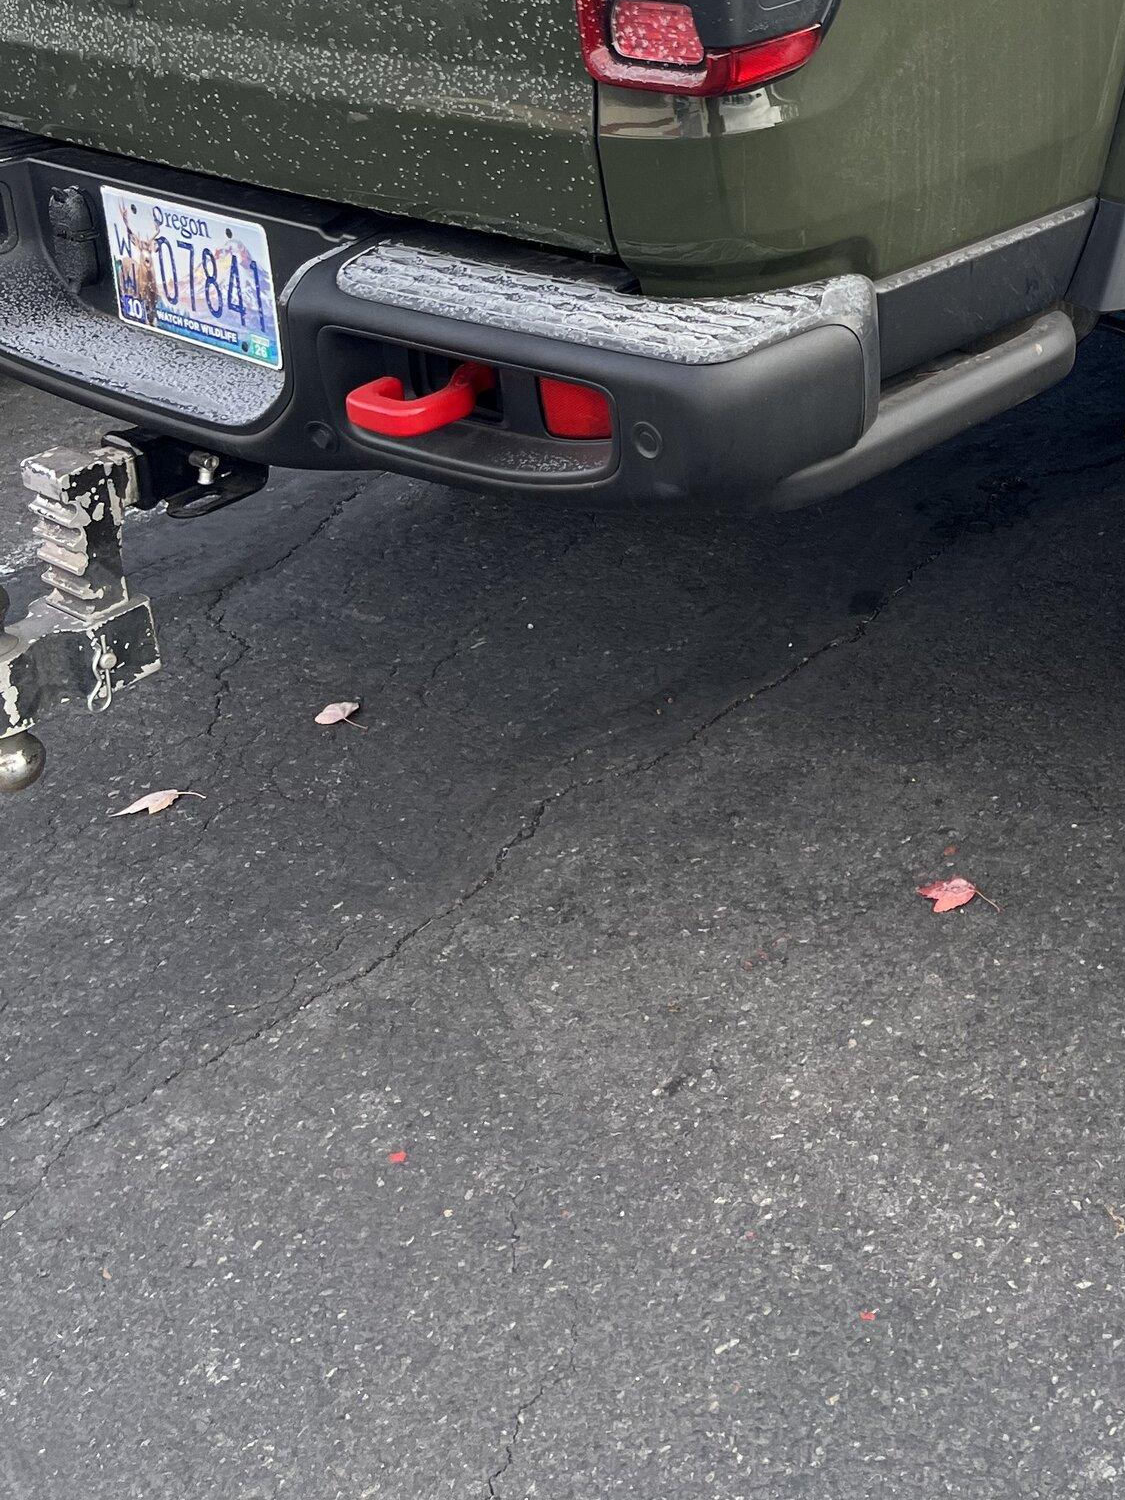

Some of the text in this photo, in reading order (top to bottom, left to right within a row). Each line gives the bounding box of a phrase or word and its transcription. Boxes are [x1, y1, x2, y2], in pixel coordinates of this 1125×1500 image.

[152, 205, 212, 239] Oregon
[113, 222, 134, 258] W
[155, 235, 266, 333] 07841
[127, 298, 143, 319] 10
[156, 309, 183, 327] WATCH
[183, 318, 201, 332] FOR
[200, 323, 238, 343] WILDLIFE
